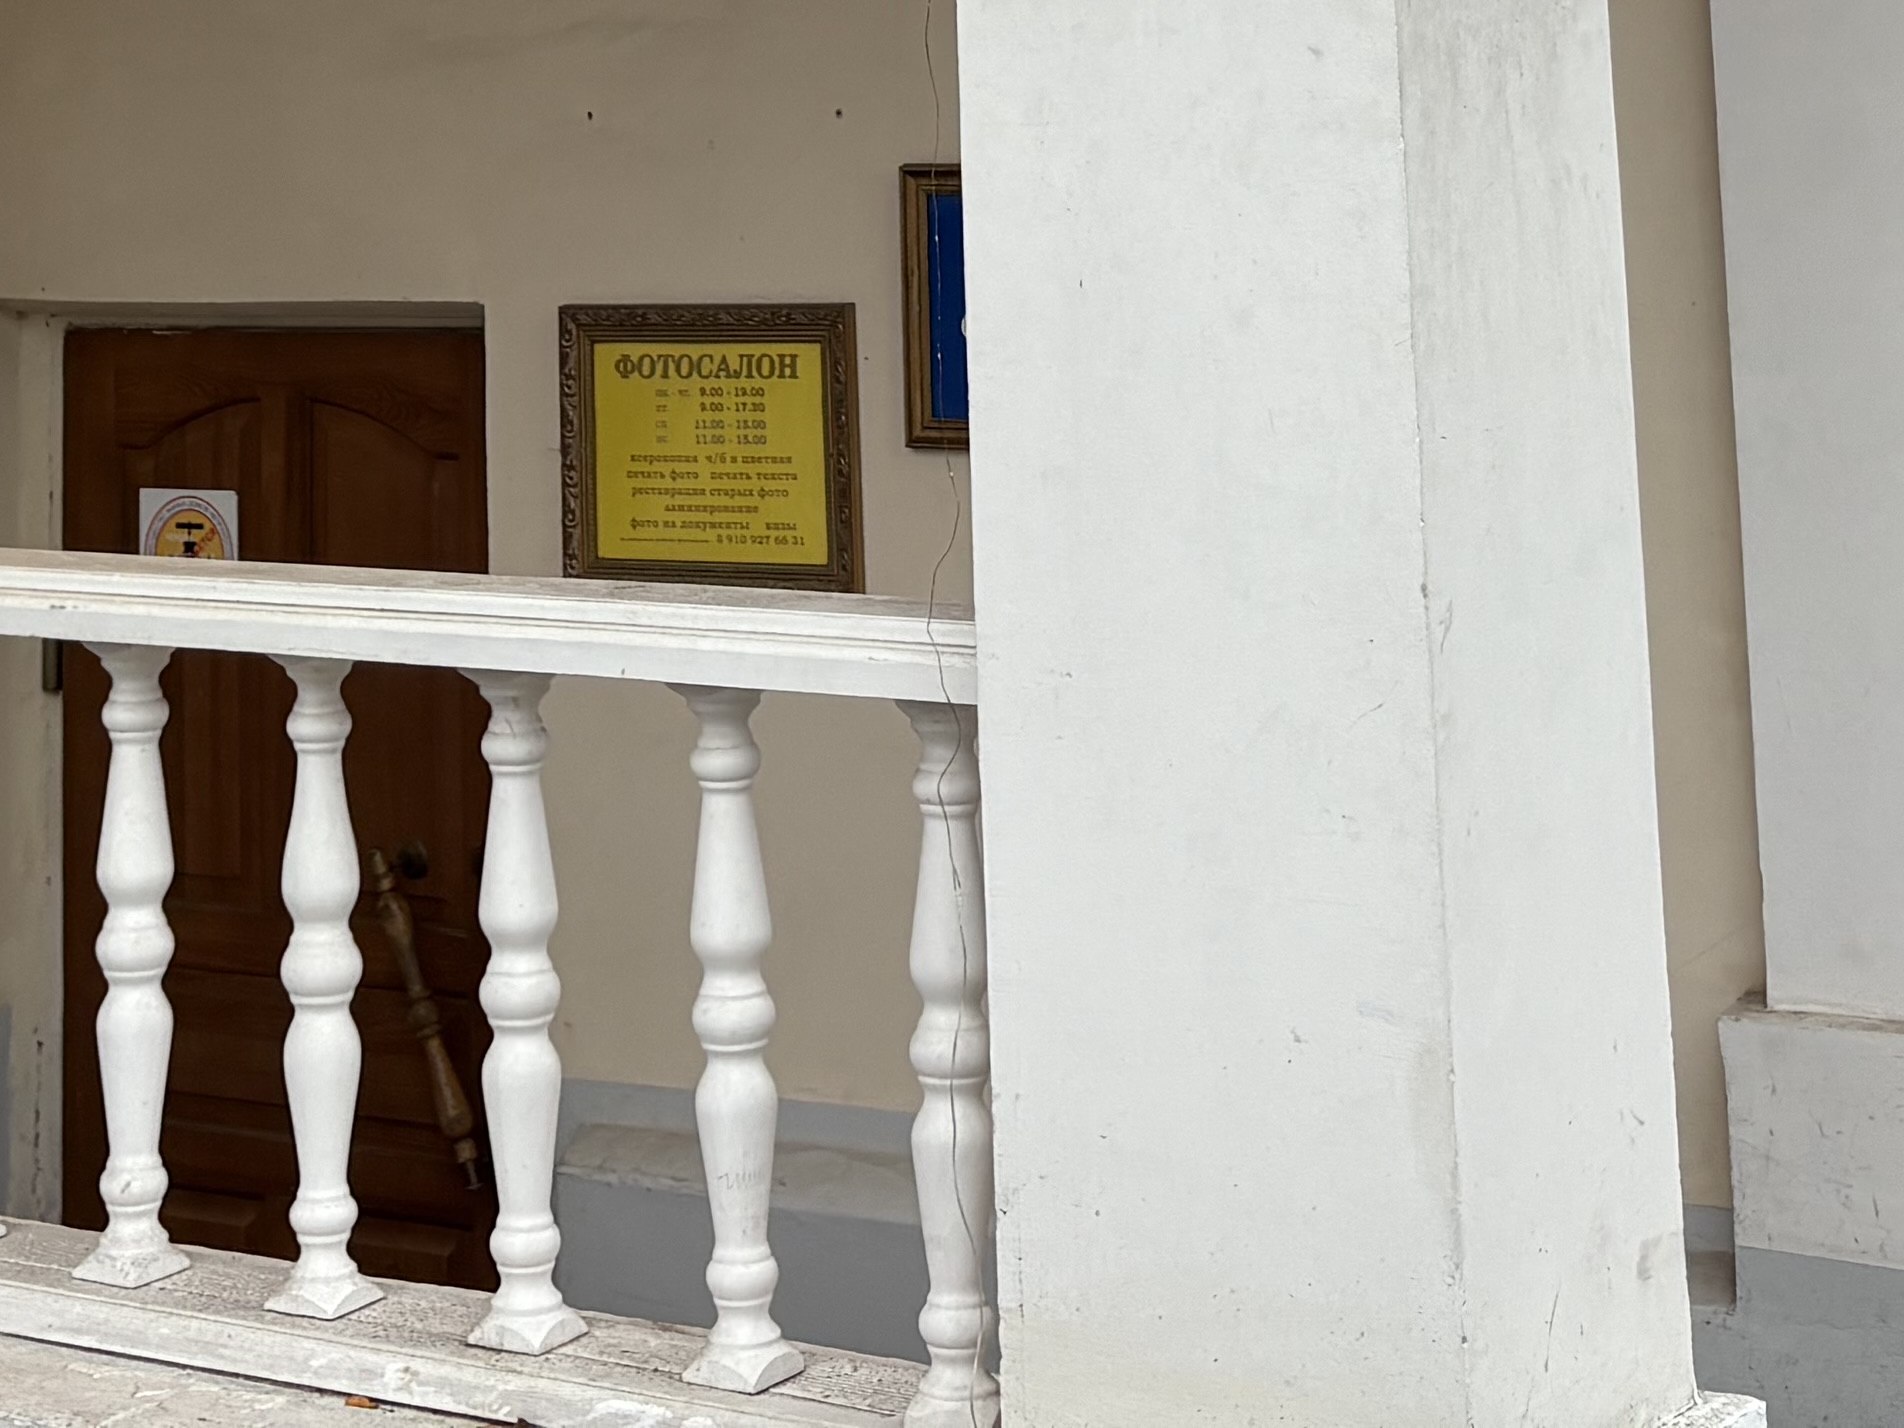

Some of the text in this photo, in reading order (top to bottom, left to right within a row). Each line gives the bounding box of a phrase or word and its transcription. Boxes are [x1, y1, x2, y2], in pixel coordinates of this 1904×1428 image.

[614, 353, 799, 380] ФОТОСАЛОН
[669, 468, 699, 482] фото
[757, 486, 789, 500] фото
[630, 517, 659, 531] фото
